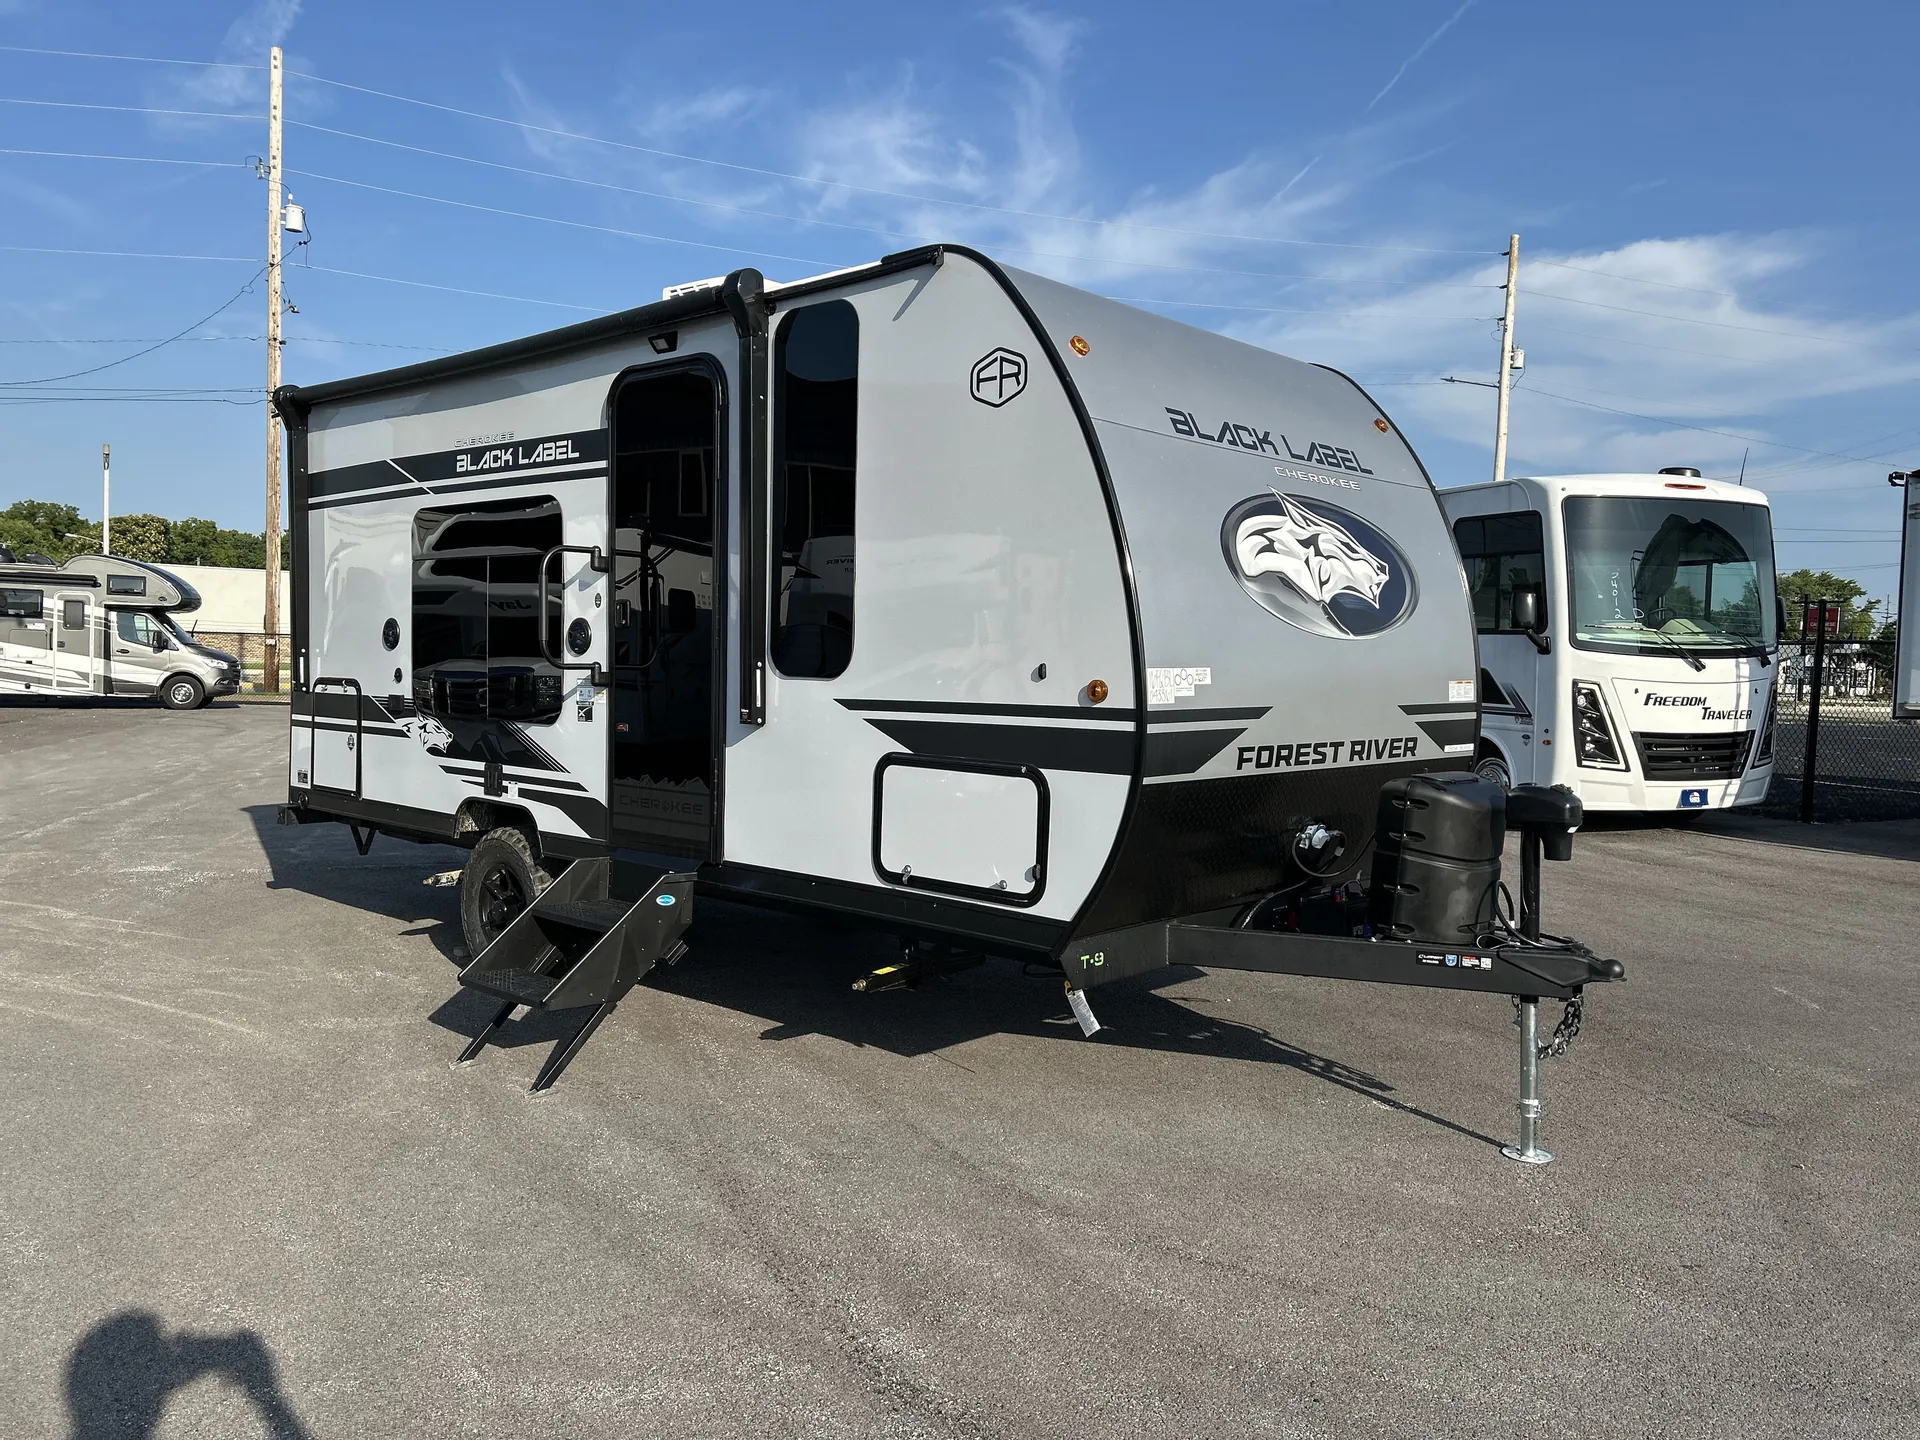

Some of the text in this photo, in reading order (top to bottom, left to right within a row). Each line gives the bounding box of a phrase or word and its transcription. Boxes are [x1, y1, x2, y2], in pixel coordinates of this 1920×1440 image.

[454, 431, 515, 448] CHEROKEE
[1164, 406, 1375, 475] BLACK LABEL
[456, 439, 580, 472] BLACK LABEL
[1274, 466, 1361, 491] CHEROKEE
[1643, 692, 1708, 707] FREEDOM
[1701, 706, 1753, 720] TRAVELER
[1236, 736, 1419, 771] FOREST RIVER
